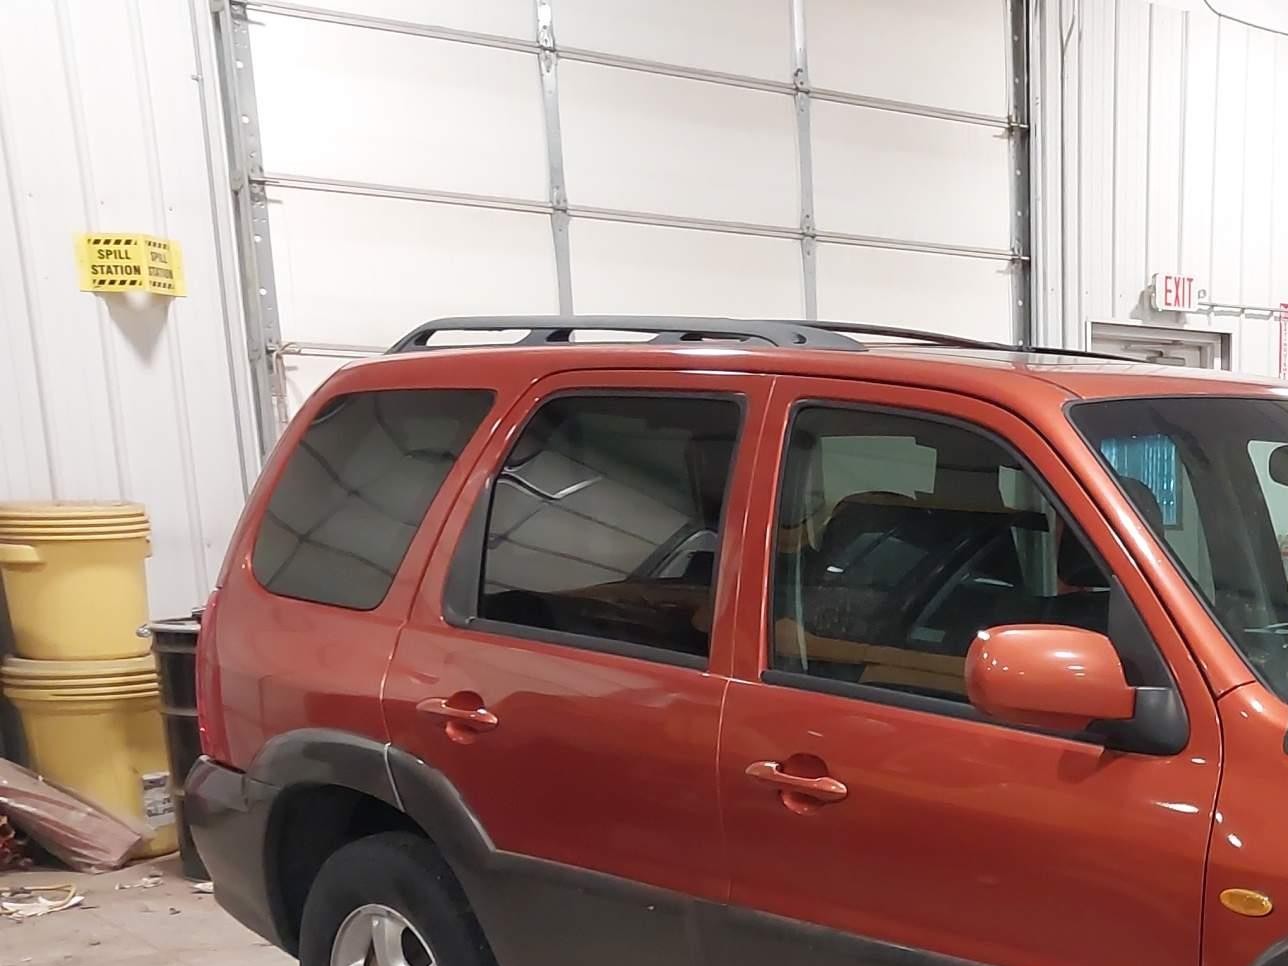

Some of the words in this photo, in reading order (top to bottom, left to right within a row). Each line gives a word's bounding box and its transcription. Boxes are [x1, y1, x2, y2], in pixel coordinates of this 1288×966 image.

[97, 249, 131, 260] SPILL
[91, 264, 141, 276] STATION
[1164, 275, 1194, 309] EXIT
